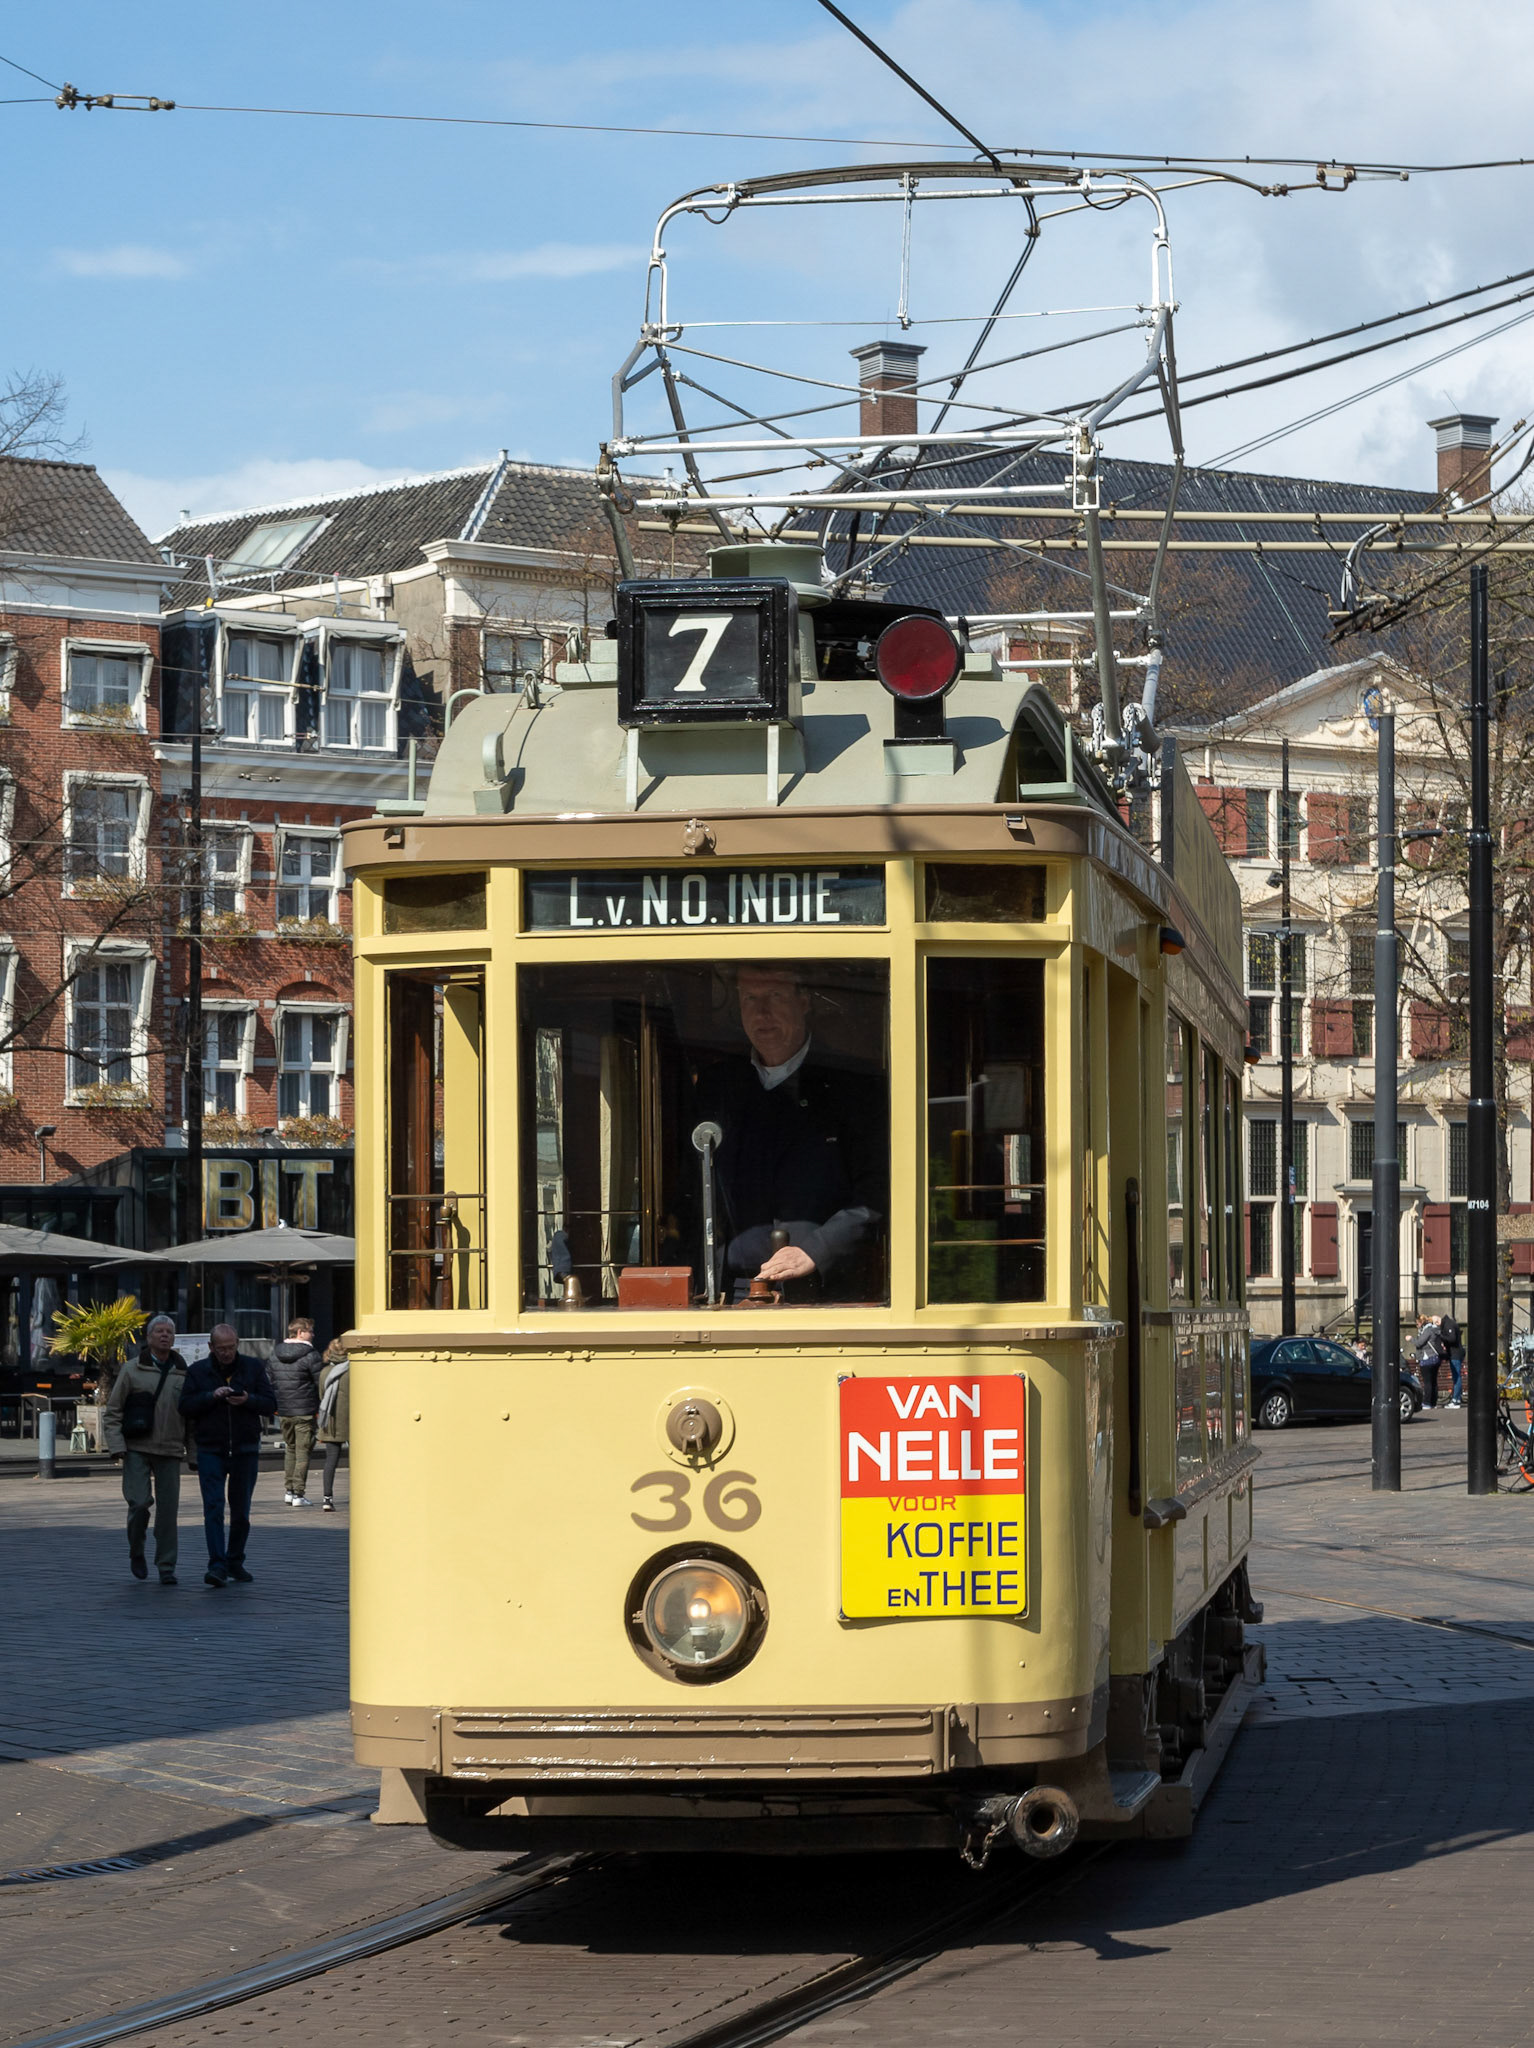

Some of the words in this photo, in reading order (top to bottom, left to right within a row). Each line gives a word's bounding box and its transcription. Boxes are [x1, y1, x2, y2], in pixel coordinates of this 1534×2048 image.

[668, 612, 734, 692] 7
[728, 871, 841, 924] INDIE
[202, 1158, 334, 1231] BIT
[886, 1383, 981, 1420] VAN
[848, 1429, 1018, 1482] NELLE
[630, 1470, 762, 1533] 36
[888, 1495, 957, 1512] VOOR
[887, 1521, 1018, 1558] KOFFIE
